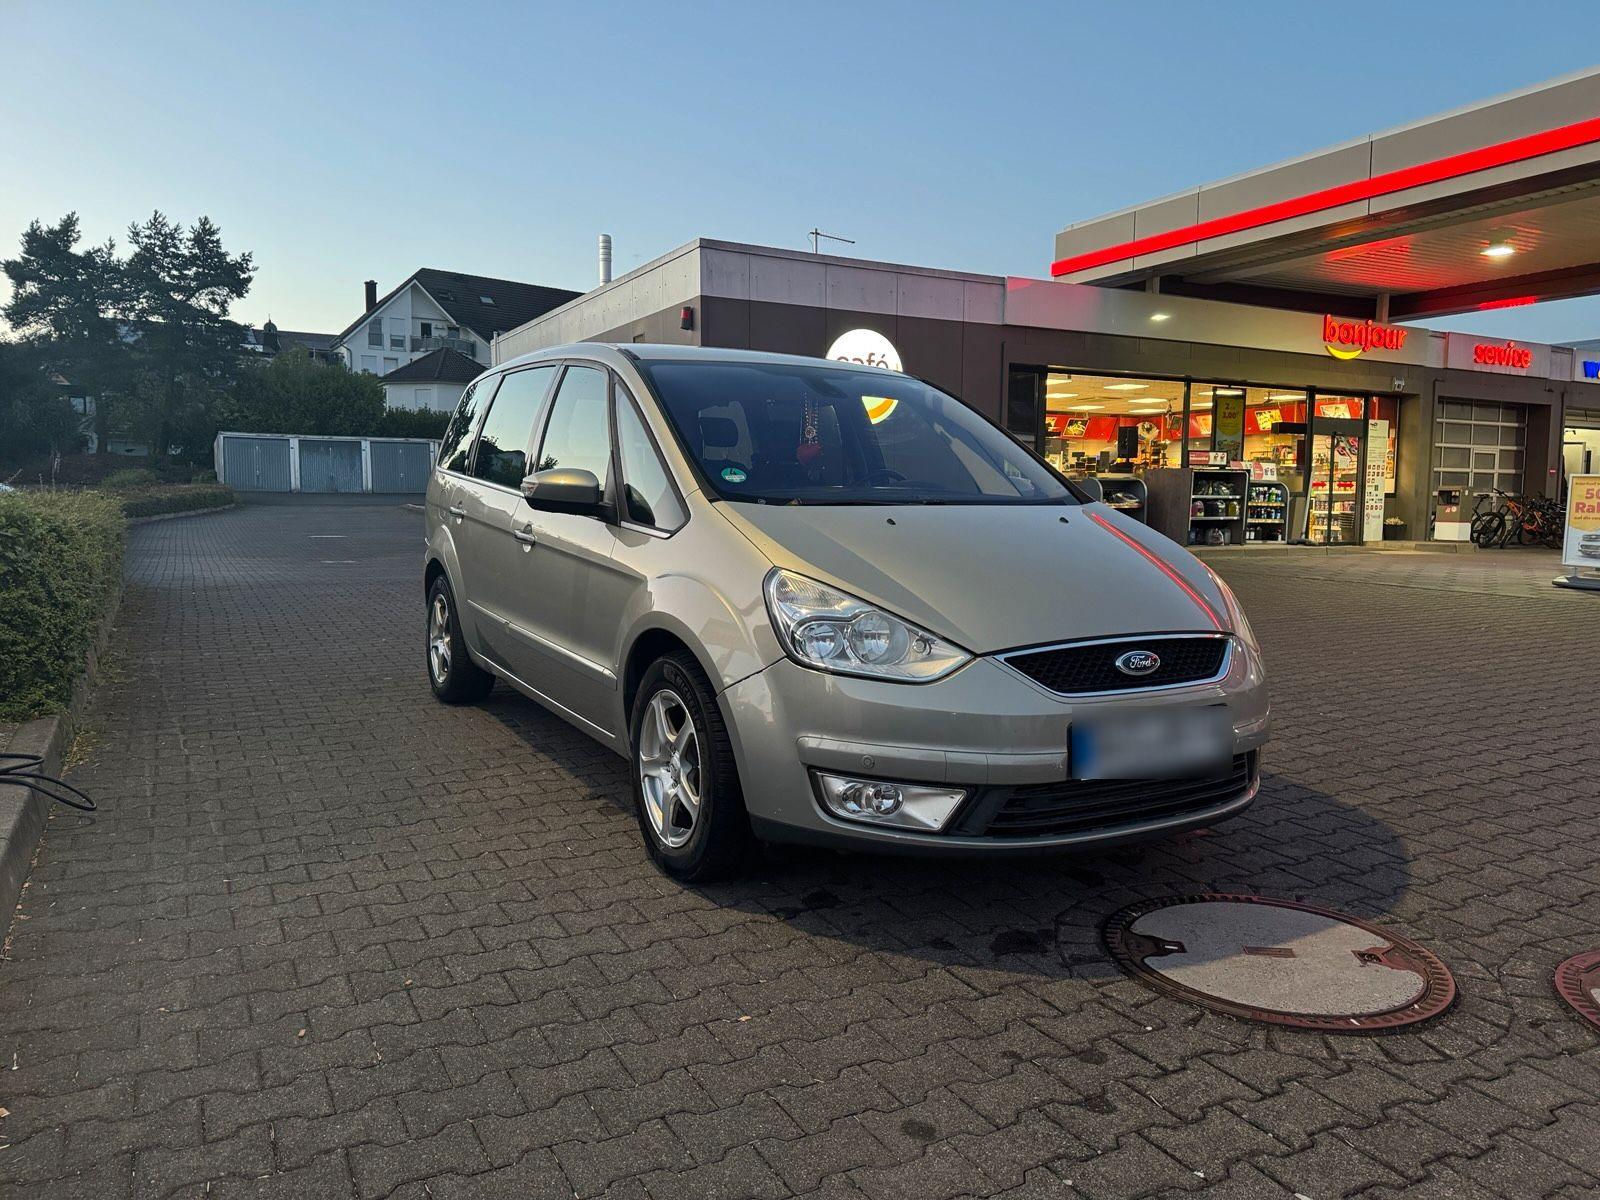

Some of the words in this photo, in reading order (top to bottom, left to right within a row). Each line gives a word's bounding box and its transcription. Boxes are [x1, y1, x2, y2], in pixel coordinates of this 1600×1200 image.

[1323, 313, 1408, 352] bonjour
[1473, 340, 1533, 369] service
[1130, 655, 1154, 669] Ford
